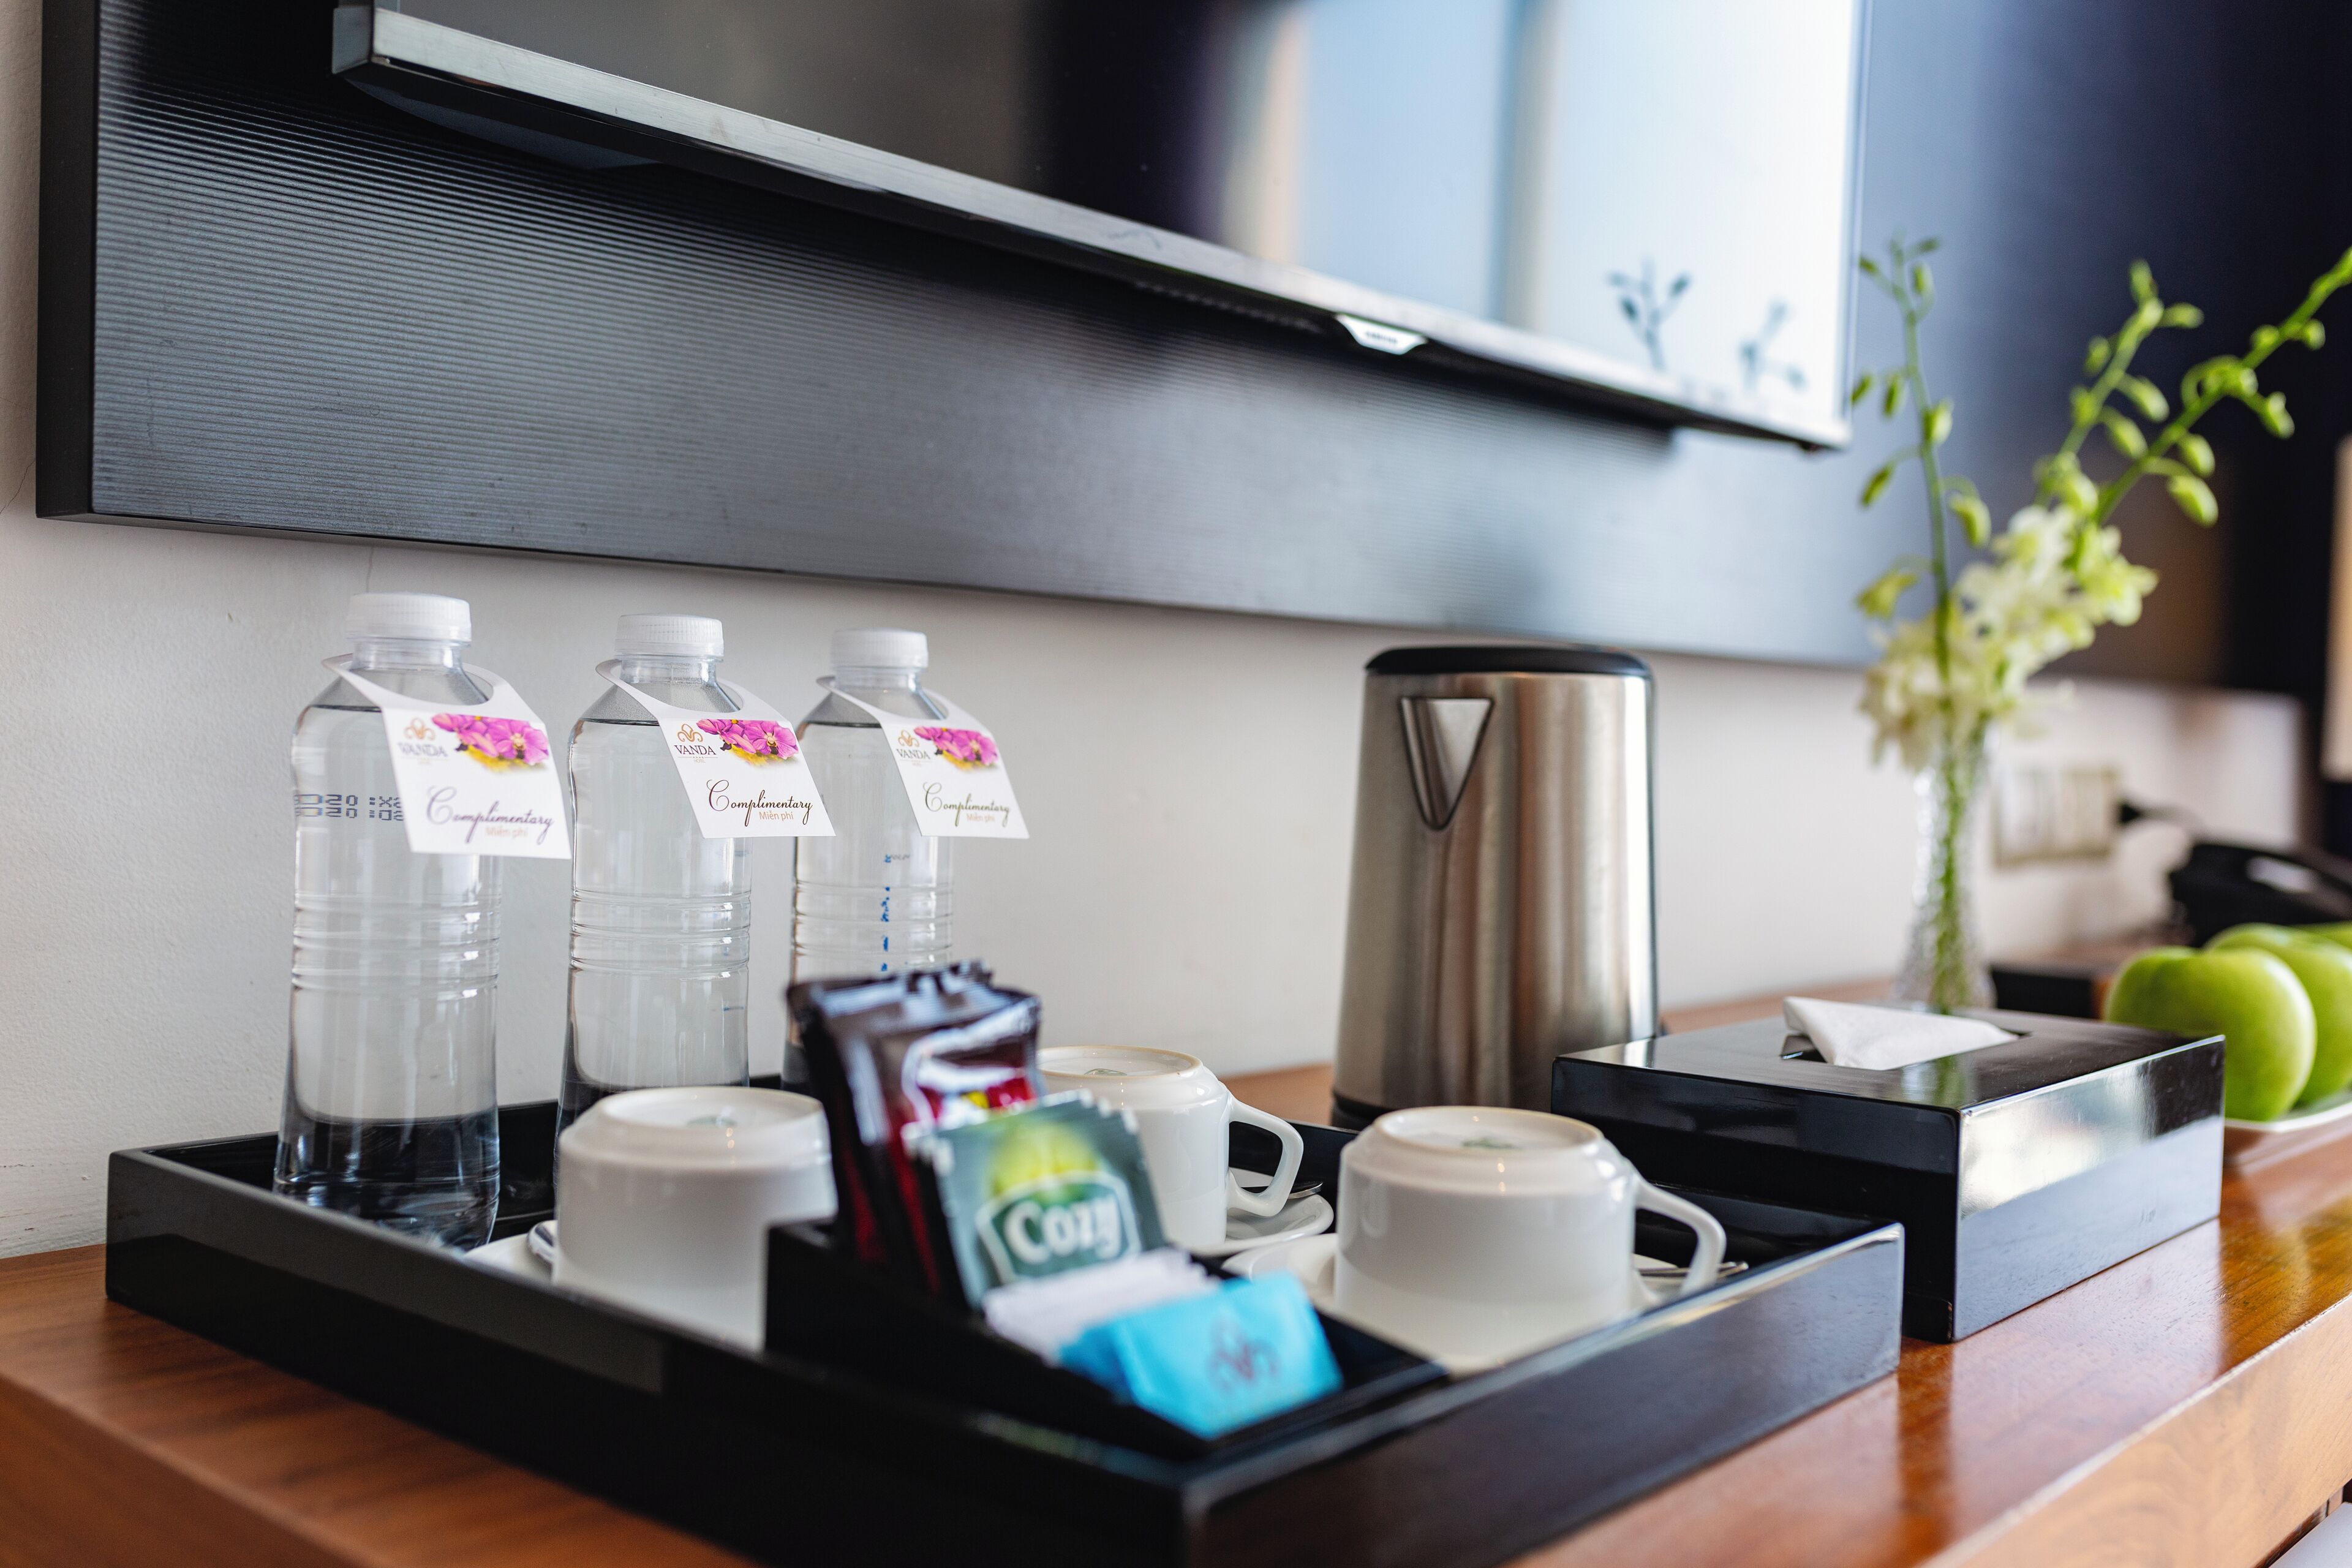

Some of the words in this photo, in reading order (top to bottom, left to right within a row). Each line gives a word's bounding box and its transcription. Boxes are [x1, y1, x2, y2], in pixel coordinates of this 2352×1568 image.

[398, 742, 448, 757] VANDA
[674, 745, 717, 755] VANDA
[896, 748, 931, 760] VANDA
[427, 786, 554, 845] Complimentary
[706, 779, 813, 827] Complimentary
[923, 782, 1011, 827] Complimentary
[1005, 1193, 1123, 1264] Cozy
